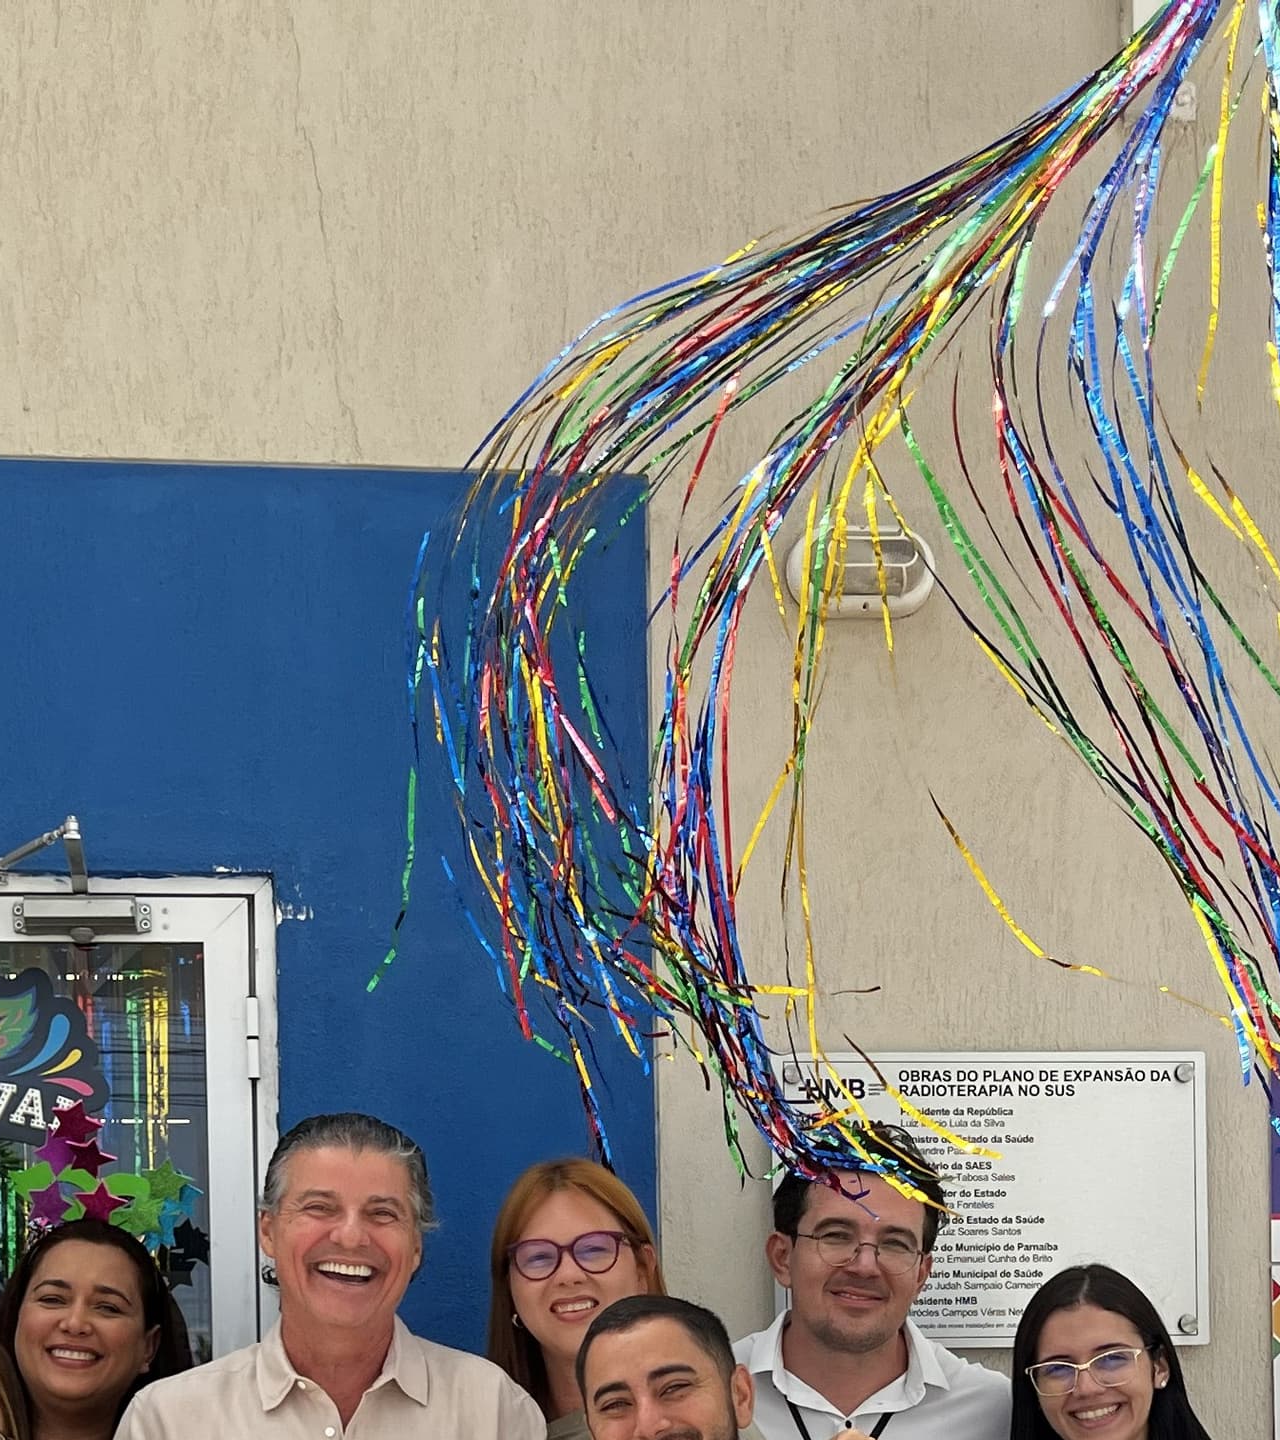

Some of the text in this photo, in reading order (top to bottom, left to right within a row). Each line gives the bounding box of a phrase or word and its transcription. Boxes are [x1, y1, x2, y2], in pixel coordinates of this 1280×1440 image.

[898, 1070, 953, 1082] OBRAS
[956, 1070, 979, 1082] DO
[983, 1070, 1034, 1082] PLANO
[1039, 1070, 1059, 1082] DE
[1063, 1067, 1146, 1082] EXPANSÃO
[1150, 1070, 1171, 1082] DA
[898, 1084, 1013, 1097] RADIOTERAPIA
[1018, 1084, 1040, 1097] NO
[1045, 1084, 1075, 1097] SUS
[953, 1107, 964, 1116] da
[967, 1107, 1013, 1117] República
[950, 1119, 968, 1128] Lula
[970, 1119, 981, 1128] da
[984, 1118, 1005, 1128] Silva
[991, 1135, 1002, 1144] da
[1005, 1134, 1034, 1144] Saúde
[951, 1161, 963, 1170] da
[965, 1161, 992, 1170] SAES
[960, 1189, 972, 1198] do
[974, 1189, 1007, 1198] Estado
[967, 1215, 999, 1224] Estado
[1001, 1215, 1013, 1224] da
[1015, 1215, 1045, 1224] Saúde
[958, 1227, 989, 1236] Soares
[991, 1227, 1022, 1236] Santos
[956, 1243, 1001, 1253] Município
[1017, 1242, 1058, 1251] Parnaíba
[947, 1254, 986, 1264] Emanuel
[988, 1254, 1017, 1263] Cunha
[1032, 1253, 1053, 1263] Brito
[953, 1269, 997, 1280] Municipal
[1013, 1269, 1043, 1278] Saúde
[935, 1281, 962, 1290] Judah
[964, 1281, 1003, 1291] Sampaio
[955, 1296, 978, 1305] HMB
[941, 1308, 978, 1319] Campos
